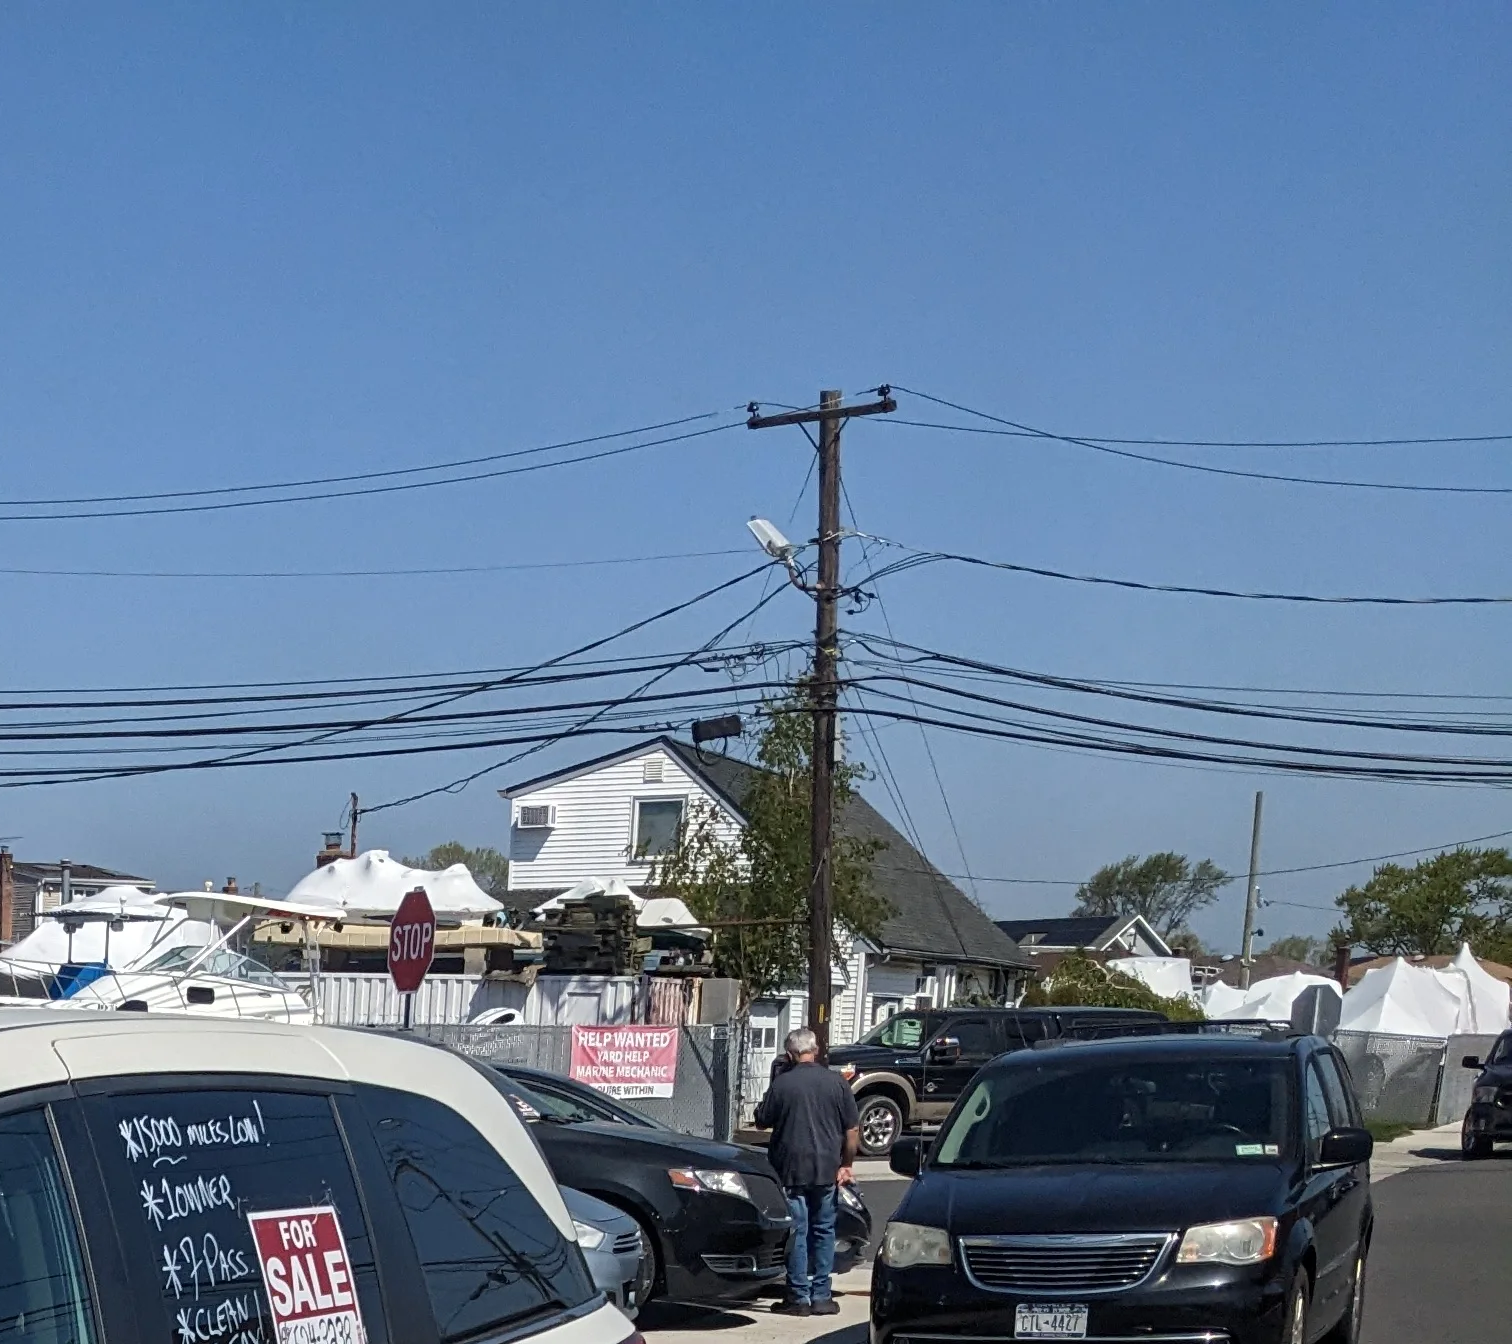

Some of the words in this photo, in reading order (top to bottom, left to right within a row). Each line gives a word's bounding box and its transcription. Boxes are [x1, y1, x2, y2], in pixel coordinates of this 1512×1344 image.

[391, 922, 432, 962] STOP
[578, 1031, 612, 1048] HELP
[614, 1031, 671, 1048] WANTED
[597, 1050, 622, 1063] YARD
[625, 1050, 650, 1063] HELP
[576, 1065, 615, 1078] MARINE
[616, 1065, 668, 1078] MECHANIC
[623, 1086, 655, 1096] WITHIN
[187, 1119, 229, 1146] MILES
[278, 1219, 317, 1250] FOR
[266, 1250, 353, 1317] SALE
